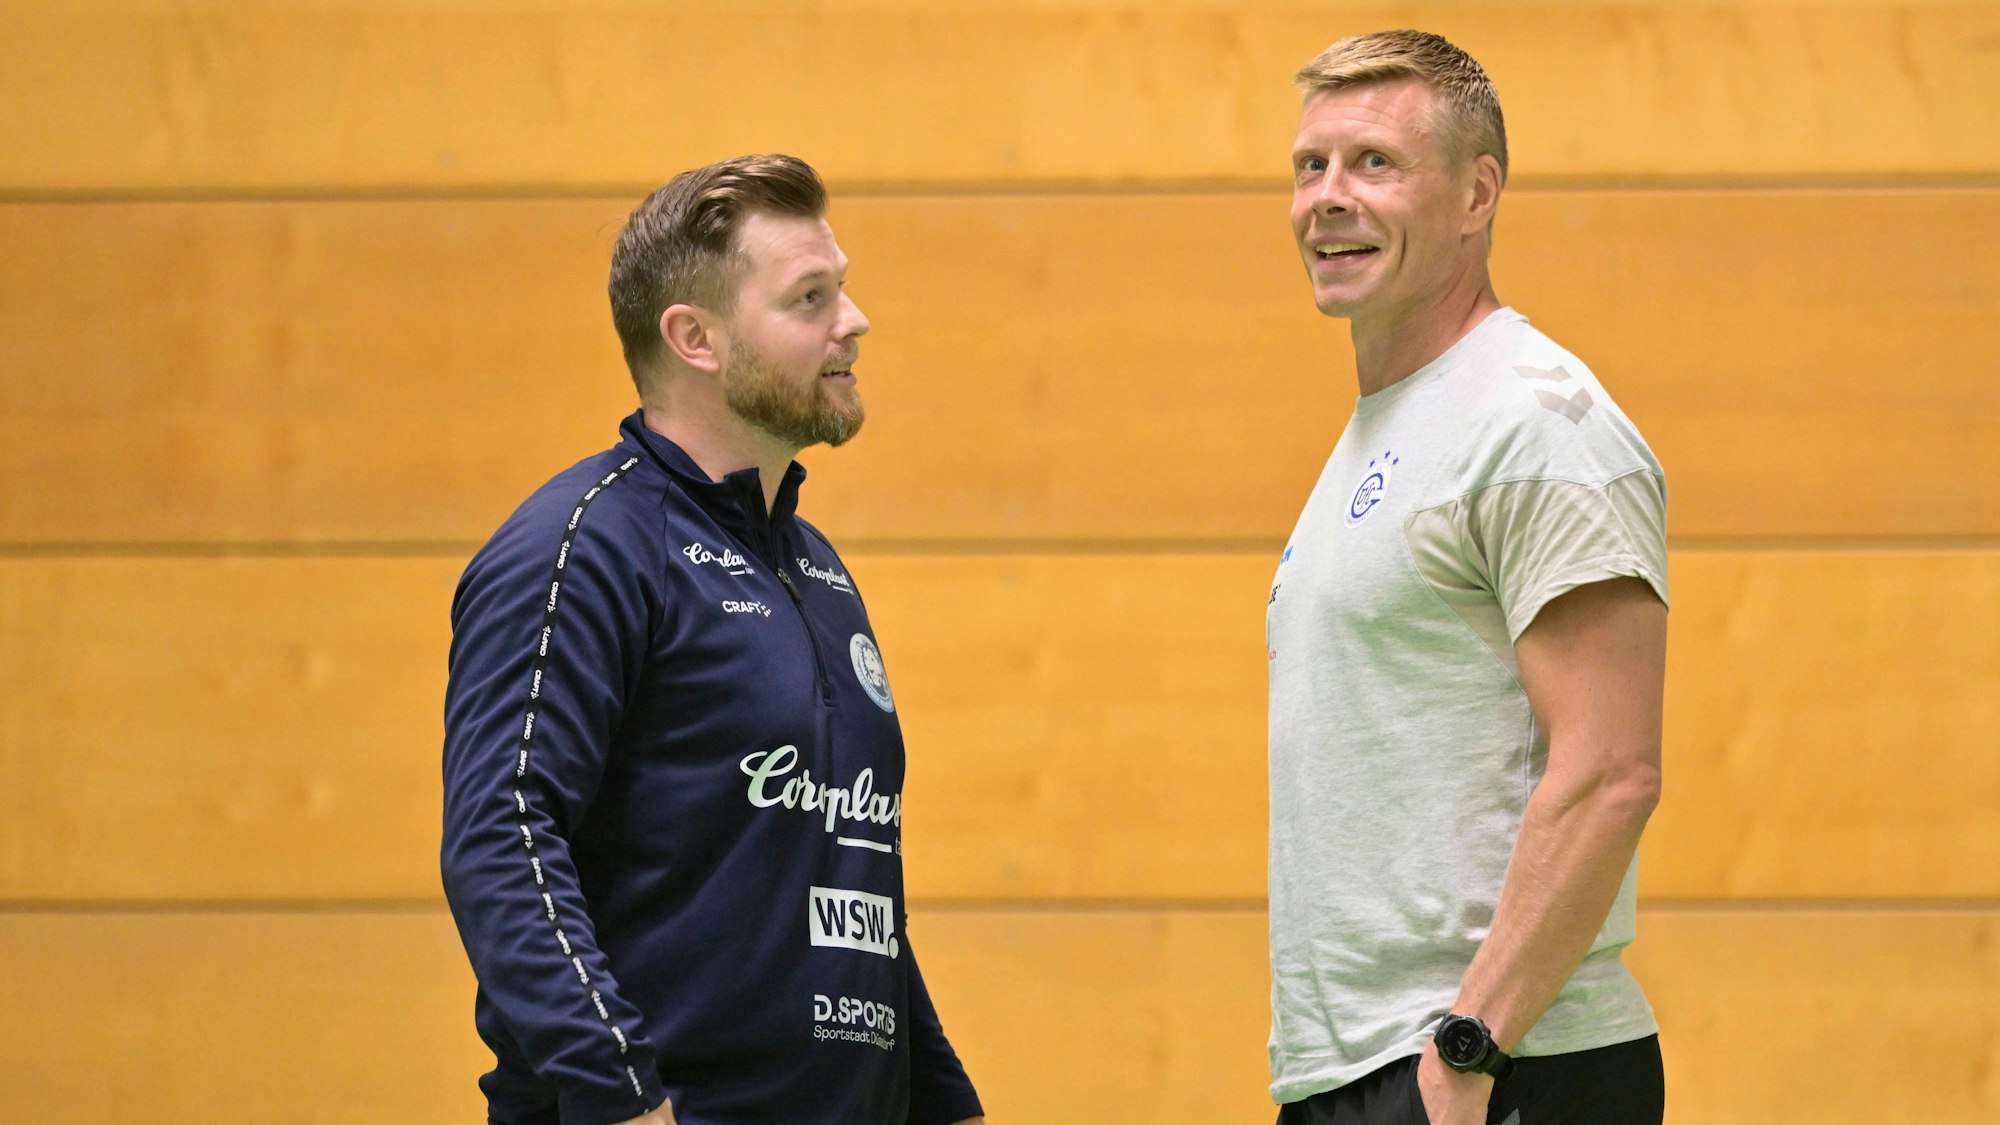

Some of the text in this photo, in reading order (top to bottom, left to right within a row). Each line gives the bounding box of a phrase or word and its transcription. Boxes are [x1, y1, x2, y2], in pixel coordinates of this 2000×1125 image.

[557, 545, 568, 570] CRAFT
[548, 581, 560, 607] CRAFT
[722, 600, 762, 614] CRAFT
[539, 631, 550, 657] CRAFT
[532, 669, 543, 694] CRAFT
[523, 717, 534, 741] CRAFT
[739, 744, 902, 832] Coroplas
[813, 993, 896, 1036] D.SPORTS
[813, 1024, 871, 1044] Sportstadt
